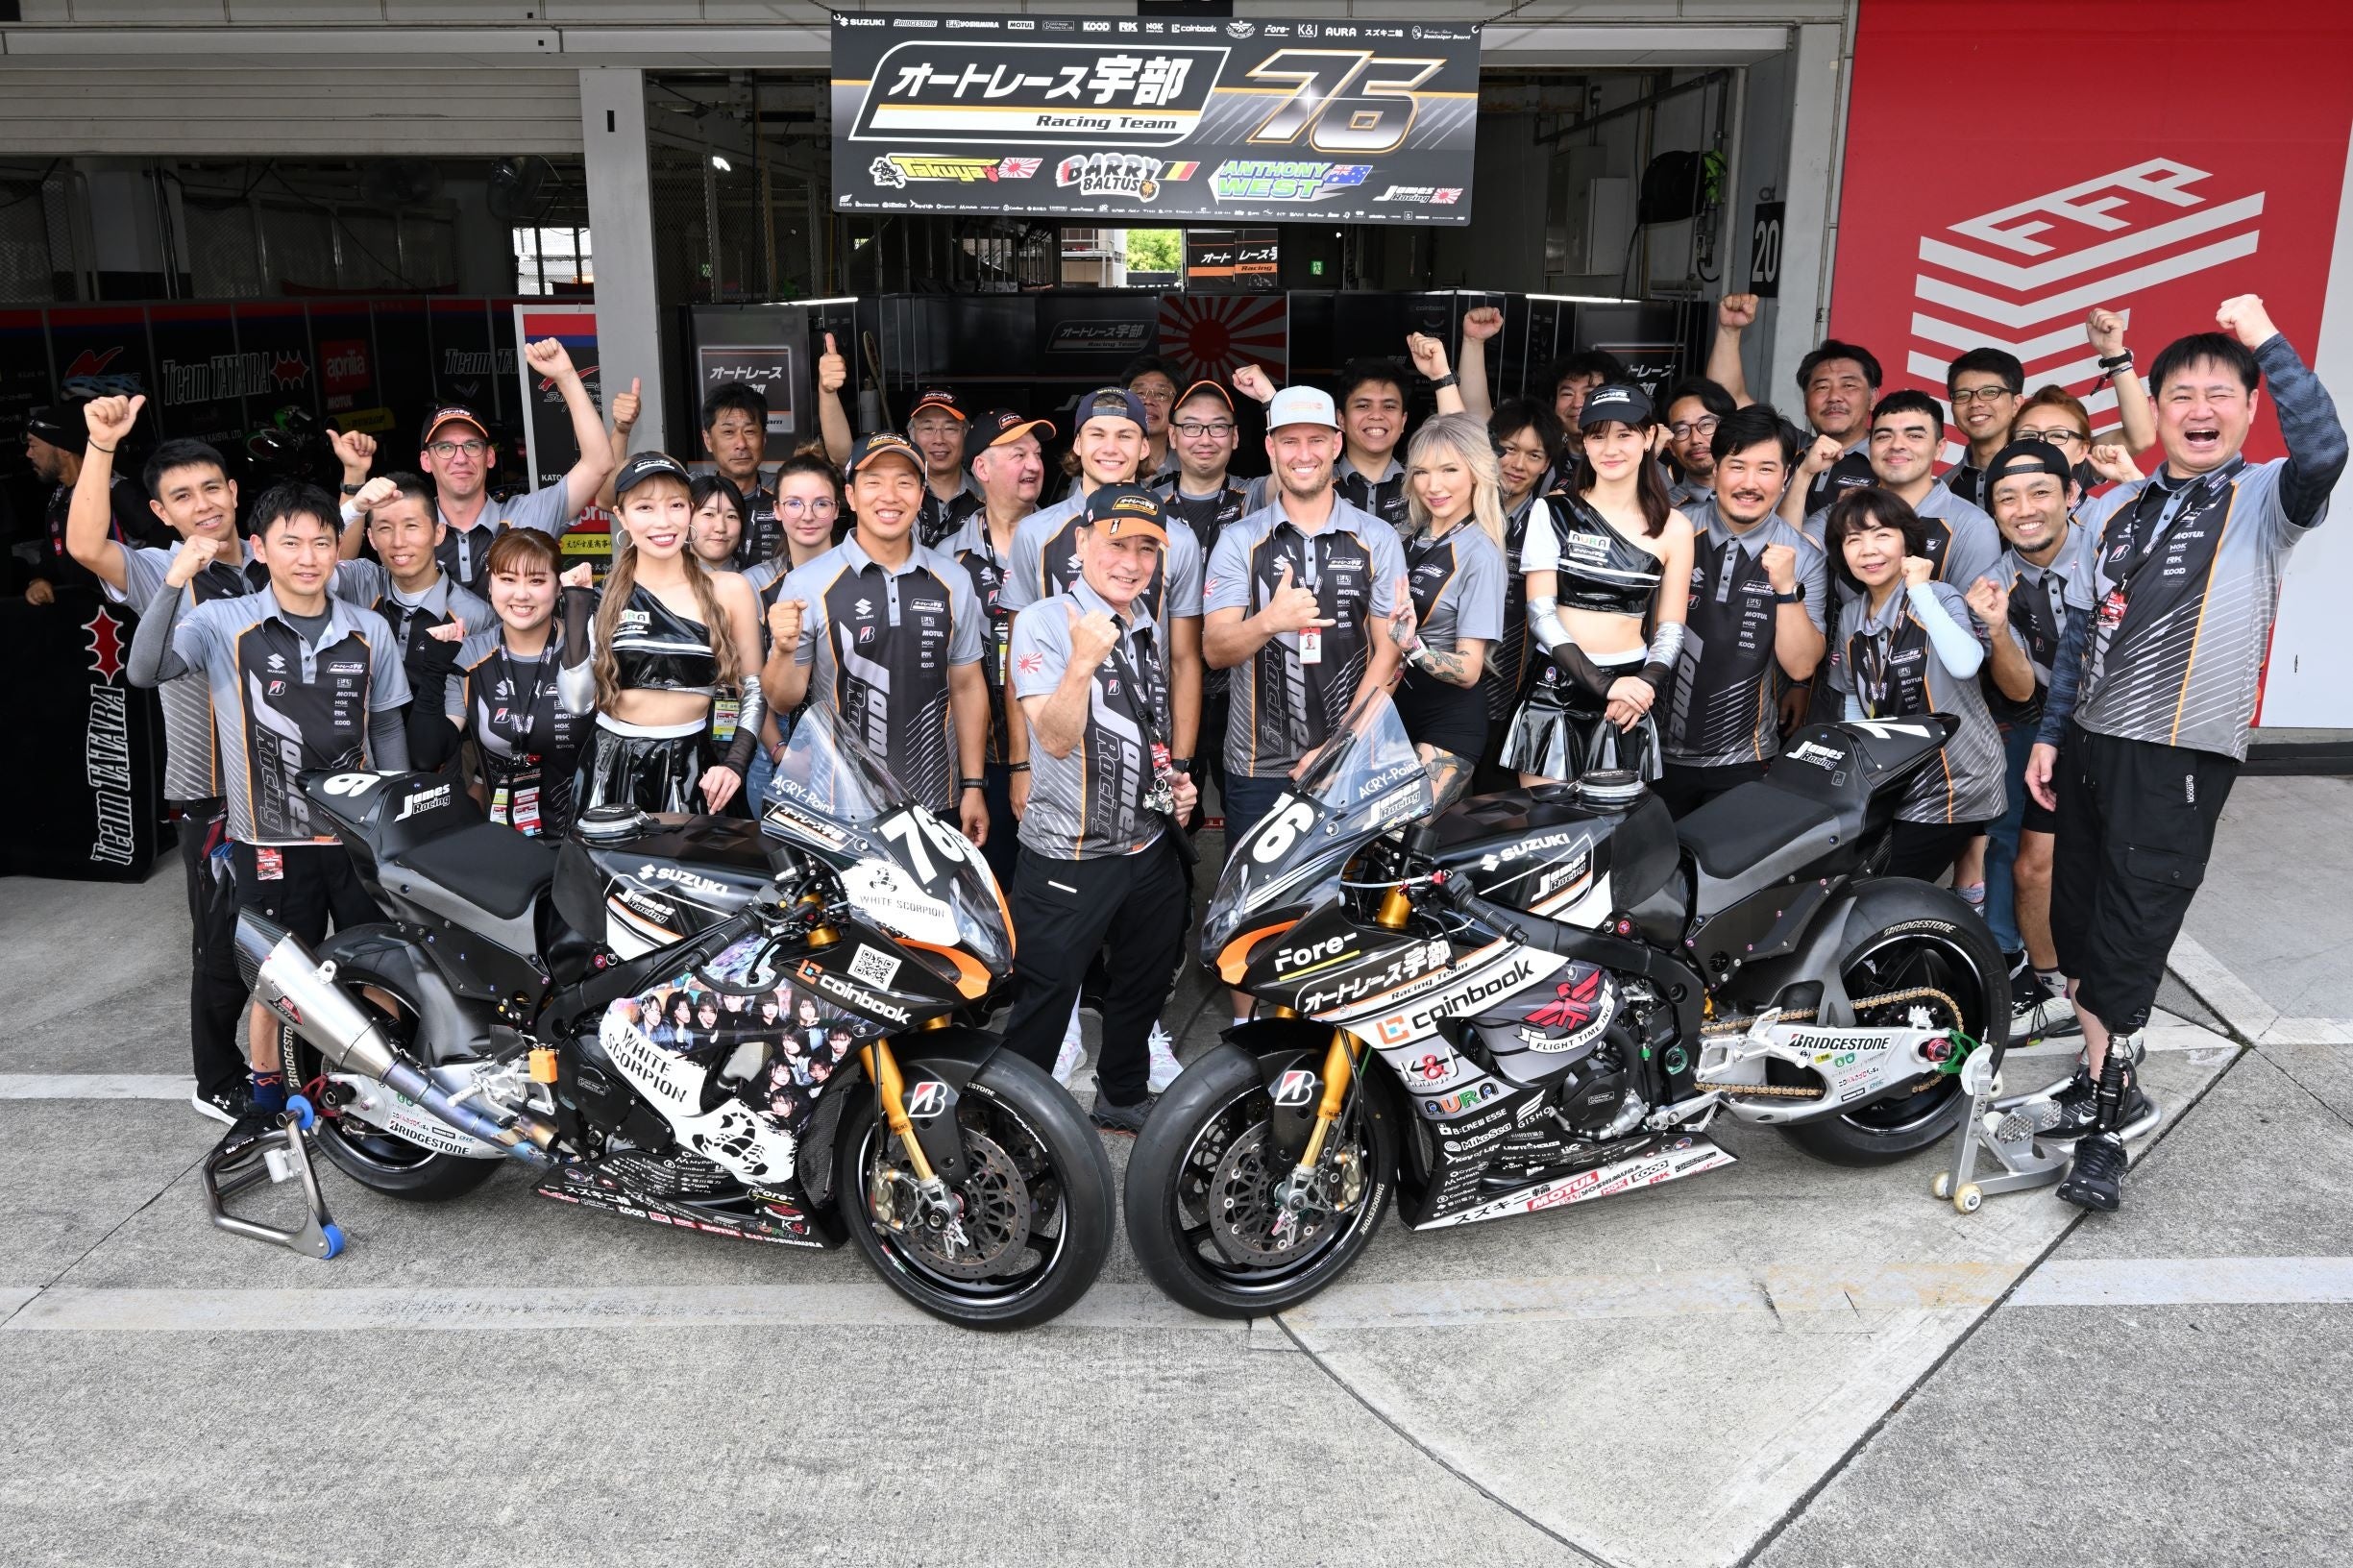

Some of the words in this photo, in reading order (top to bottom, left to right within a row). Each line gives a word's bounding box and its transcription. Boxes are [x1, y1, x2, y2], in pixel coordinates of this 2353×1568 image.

[1119, 21, 1138, 32] RK
[1298, 25, 1318, 36] K&J
[1326, 28, 1347, 37] AURA
[888, 55, 1193, 106] オートレース宇部
[1245, 48, 1447, 154] 76
[1036, 115, 1112, 131] Racing
[1118, 117, 1177, 129] Team
[1064, 154, 1161, 181] BARRY
[1220, 160, 1334, 177] ANTHONY
[1083, 179, 1140, 191] BALTUS
[1218, 178, 1324, 198] WEST
[1373, 185, 1434, 202] James
[1391, 194, 1430, 204] Racing
[1201, 252, 1232, 263] オート
[1751, 219, 1779, 282] 20
[1061, 325, 1145, 338] オートレース宇部
[327, 350, 366, 381] aprilia
[445, 348, 491, 375] Team
[709, 366, 782, 380] オートレース
[161, 359, 209, 405] Team
[210, 352, 272, 401] TATARA
[328, 394, 354, 409] MOTUL
[1572, 534, 1606, 548] AURA
[2169, 542, 2188, 551] NGK
[2172, 530, 2204, 541] MOTUL
[2163, 567, 2187, 576] KOOD
[2166, 555, 2183, 565] RK
[1409, 586, 1425, 596] OTUL
[621, 612, 646, 623] URA
[1745, 611, 1768, 621] MOTUL
[1738, 640, 1756, 649] KOOD
[86, 684, 131, 792] TATARA
[1785, 741, 1846, 760] James
[1801, 751, 1837, 771] Racing
[256, 724, 285, 832] Racing
[1091, 728, 1121, 845] Racing
[1359, 759, 1421, 799] ACRY-Point
[394, 784, 450, 822] James
[413, 795, 450, 815] Racing
[772, 774, 836, 815] ACRY-Point
[1362, 780, 1420, 832] James
[1380, 790, 1420, 819] Racing
[90, 791, 135, 865] Team
[780, 805, 846, 841] オートレース宇部
[880, 805, 965, 884] 76
[1501, 832, 1570, 863] SUZUKI
[656, 869, 728, 895] SUZUKI
[1532, 850, 1586, 902] James
[1549, 864, 1586, 892] Racing
[615, 888, 675, 916] James
[628, 898, 669, 924] Racing
[859, 895, 893, 907] WHITE
[896, 899, 945, 919] SCORPION
[1883, 919, 1956, 938] BRIDGESTONE
[1304, 940, 1451, 1013] オートレース宇部
[1391, 978, 1434, 1000] Racing
[1436, 962, 1468, 982] Team
[820, 974, 912, 1024] coinbook
[1412, 959, 1534, 1030] coinbook
[1536, 1040, 1575, 1051] FLIGHT
[1578, 1024, 1601, 1042] TIME
[1789, 1034, 1891, 1051] BRIDGESTONE
[284, 1026, 302, 1089] BRIDGESTO
[624, 1027, 673, 1077] WHITE
[1397, 1047, 1460, 1083] K&J
[605, 1033, 688, 1103] SCORPION
[1425, 1082, 1499, 1115] AURA
[1487, 1109, 1507, 1122] ESSE
[1518, 1107, 1551, 1128] GISHO
[389, 1120, 471, 1155] BRIDGESTONE
[1581, 1164, 1643, 1197] YOSHIMURA
[1633, 1161, 1668, 1182] KOOD
[1651, 1170, 1670, 1184] RK
[565, 1186, 632, 1207] スズキ二輪
[1449, 1188, 1476, 1199] CoinBest
[1455, 1184, 1551, 1224] スズキ二輪
[1532, 1172, 1598, 1210] MOTUL
[619, 1205, 646, 1217] KOOD
[701, 1225, 741, 1237] MOTUL
[1360, 1183, 1385, 1235] BRIDGESTONE
[782, 1220, 811, 1236] K&J
